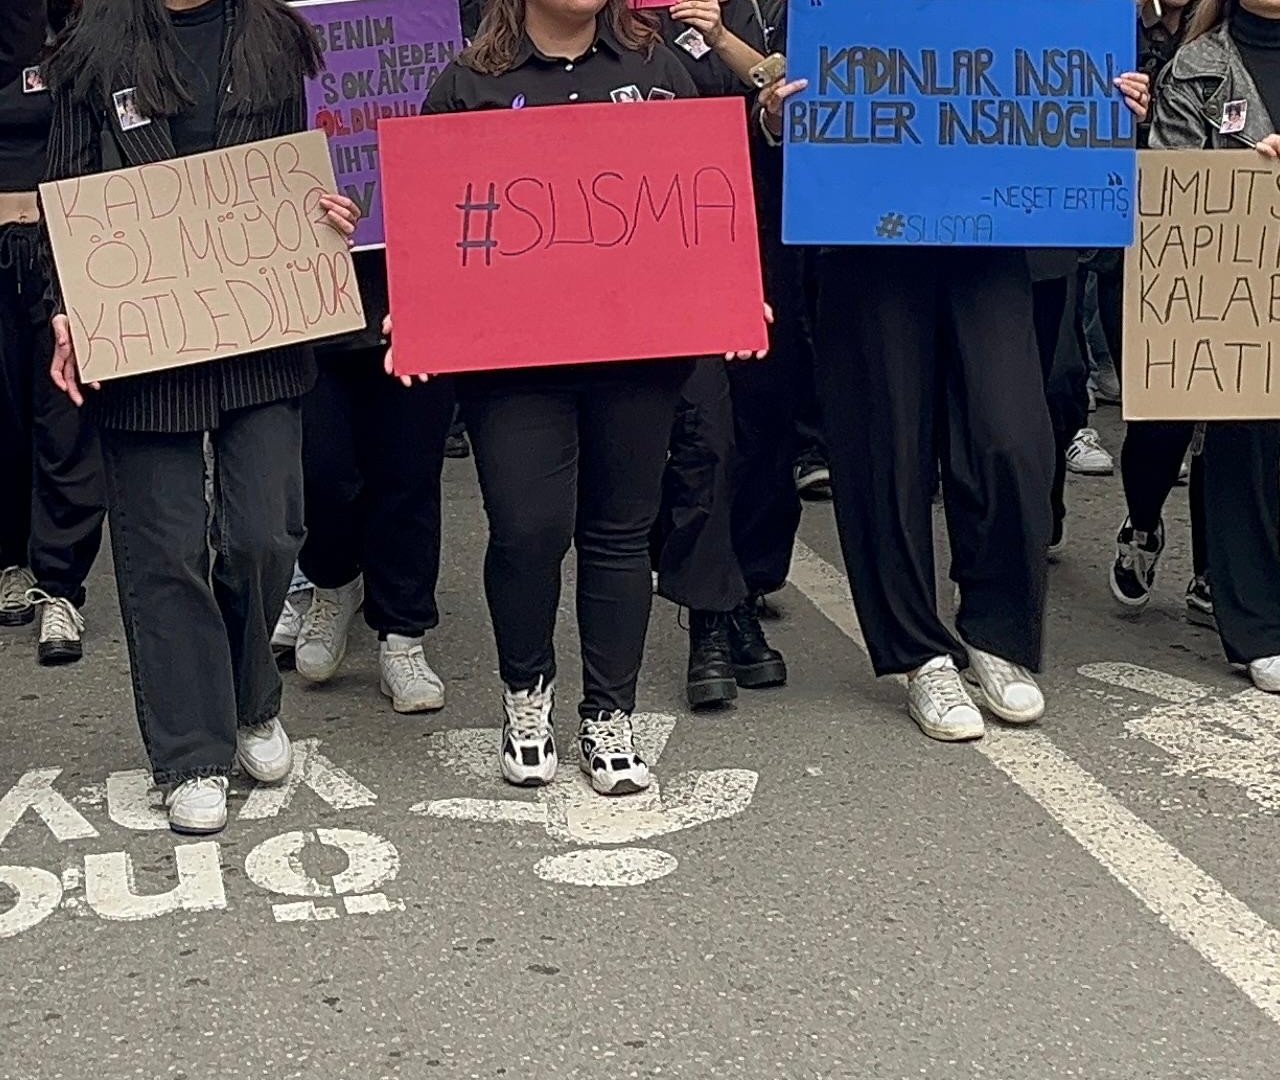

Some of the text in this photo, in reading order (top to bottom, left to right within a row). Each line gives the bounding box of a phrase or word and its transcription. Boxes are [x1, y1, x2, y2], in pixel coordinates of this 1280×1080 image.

[314, 15, 396, 53] BENİM
[377, 40, 455, 71] NEDEN
[321, 66, 444, 105] SOKAKTA
[818, 45, 1002, 98] KADINLAR
[789, 99, 1136, 150] BİZLER İNSANOĞLU
[55, 141, 325, 237] KADINLAR
[979, 185, 1130, 219] -NEŞET ERTAŞ
[85, 186, 352, 289] ÖLMÜYOR
[455, 166, 737, 268] #SUSMA
[875, 211, 995, 243] #SUSMA
[71, 250, 363, 372] KATLEDİLİYOR
